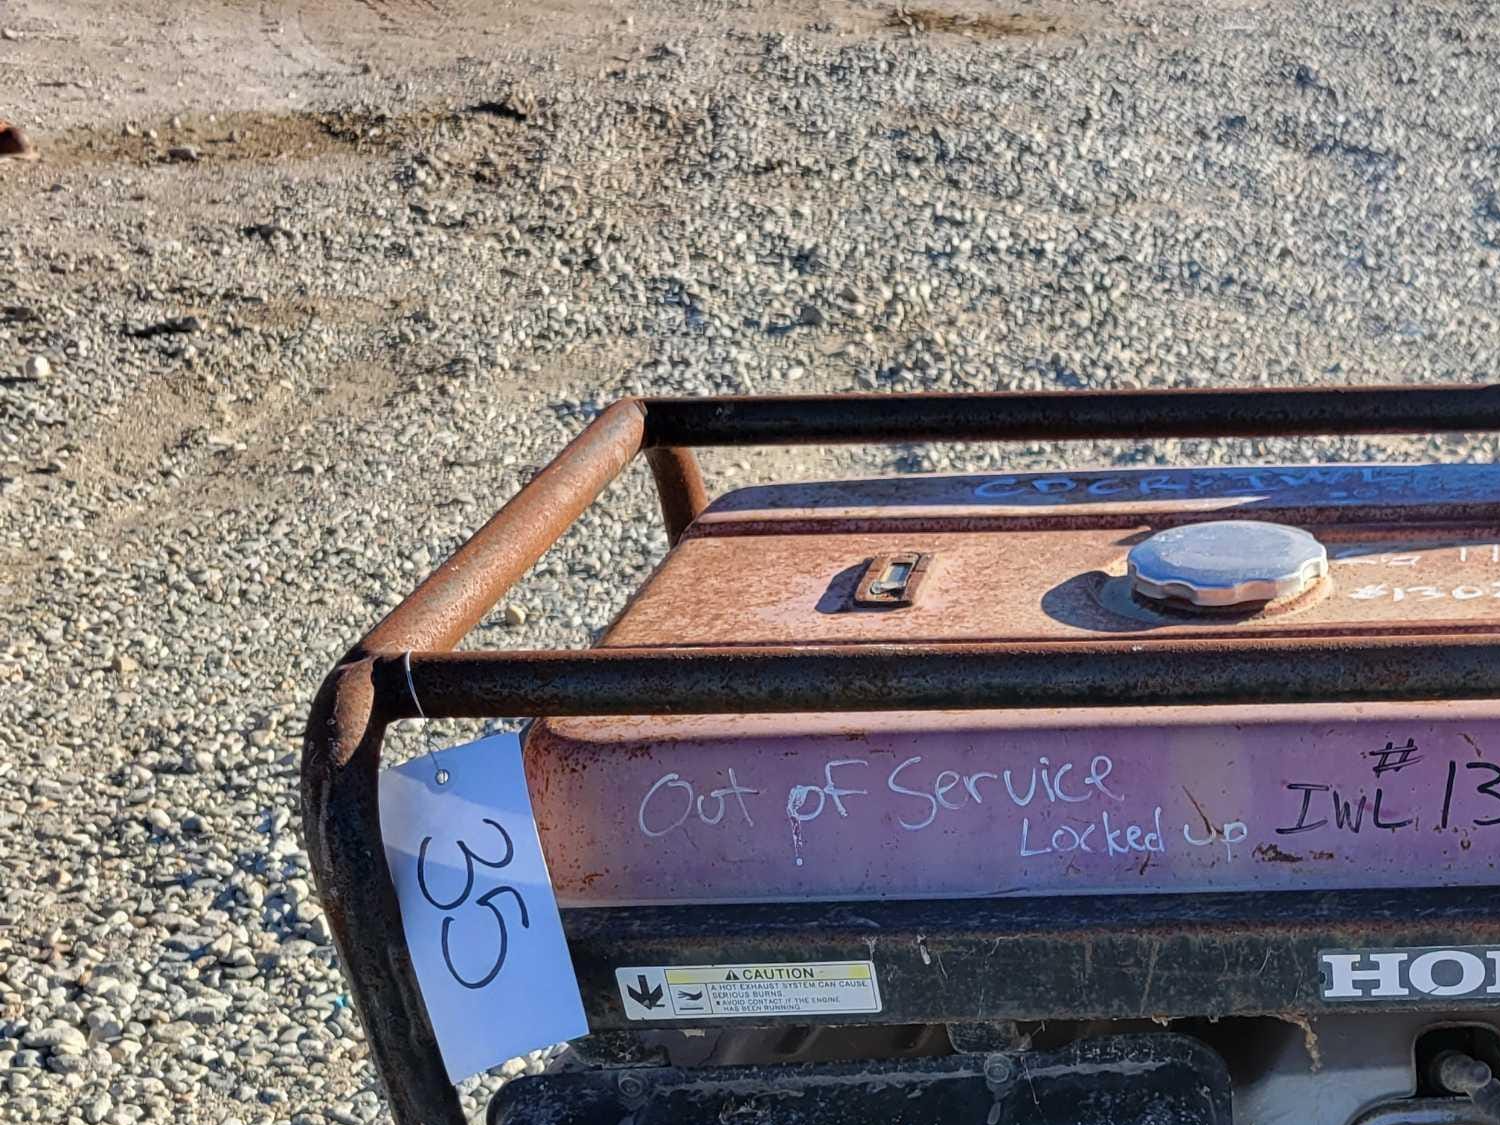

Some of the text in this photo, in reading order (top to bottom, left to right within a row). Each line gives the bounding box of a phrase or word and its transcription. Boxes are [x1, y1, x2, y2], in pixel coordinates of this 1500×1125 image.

[639, 767, 759, 838] Out
[888, 755, 1126, 830] Service
[1276, 782, 1414, 835] IWL
[1020, 806, 1165, 857] Locked
[417, 818, 530, 989] 35
[712, 991, 750, 999] SERIOUS
[742, 967, 815, 980] CAUTION
[782, 981, 816, 989] SYSTEM
[839, 980, 868, 988] CAUSE
